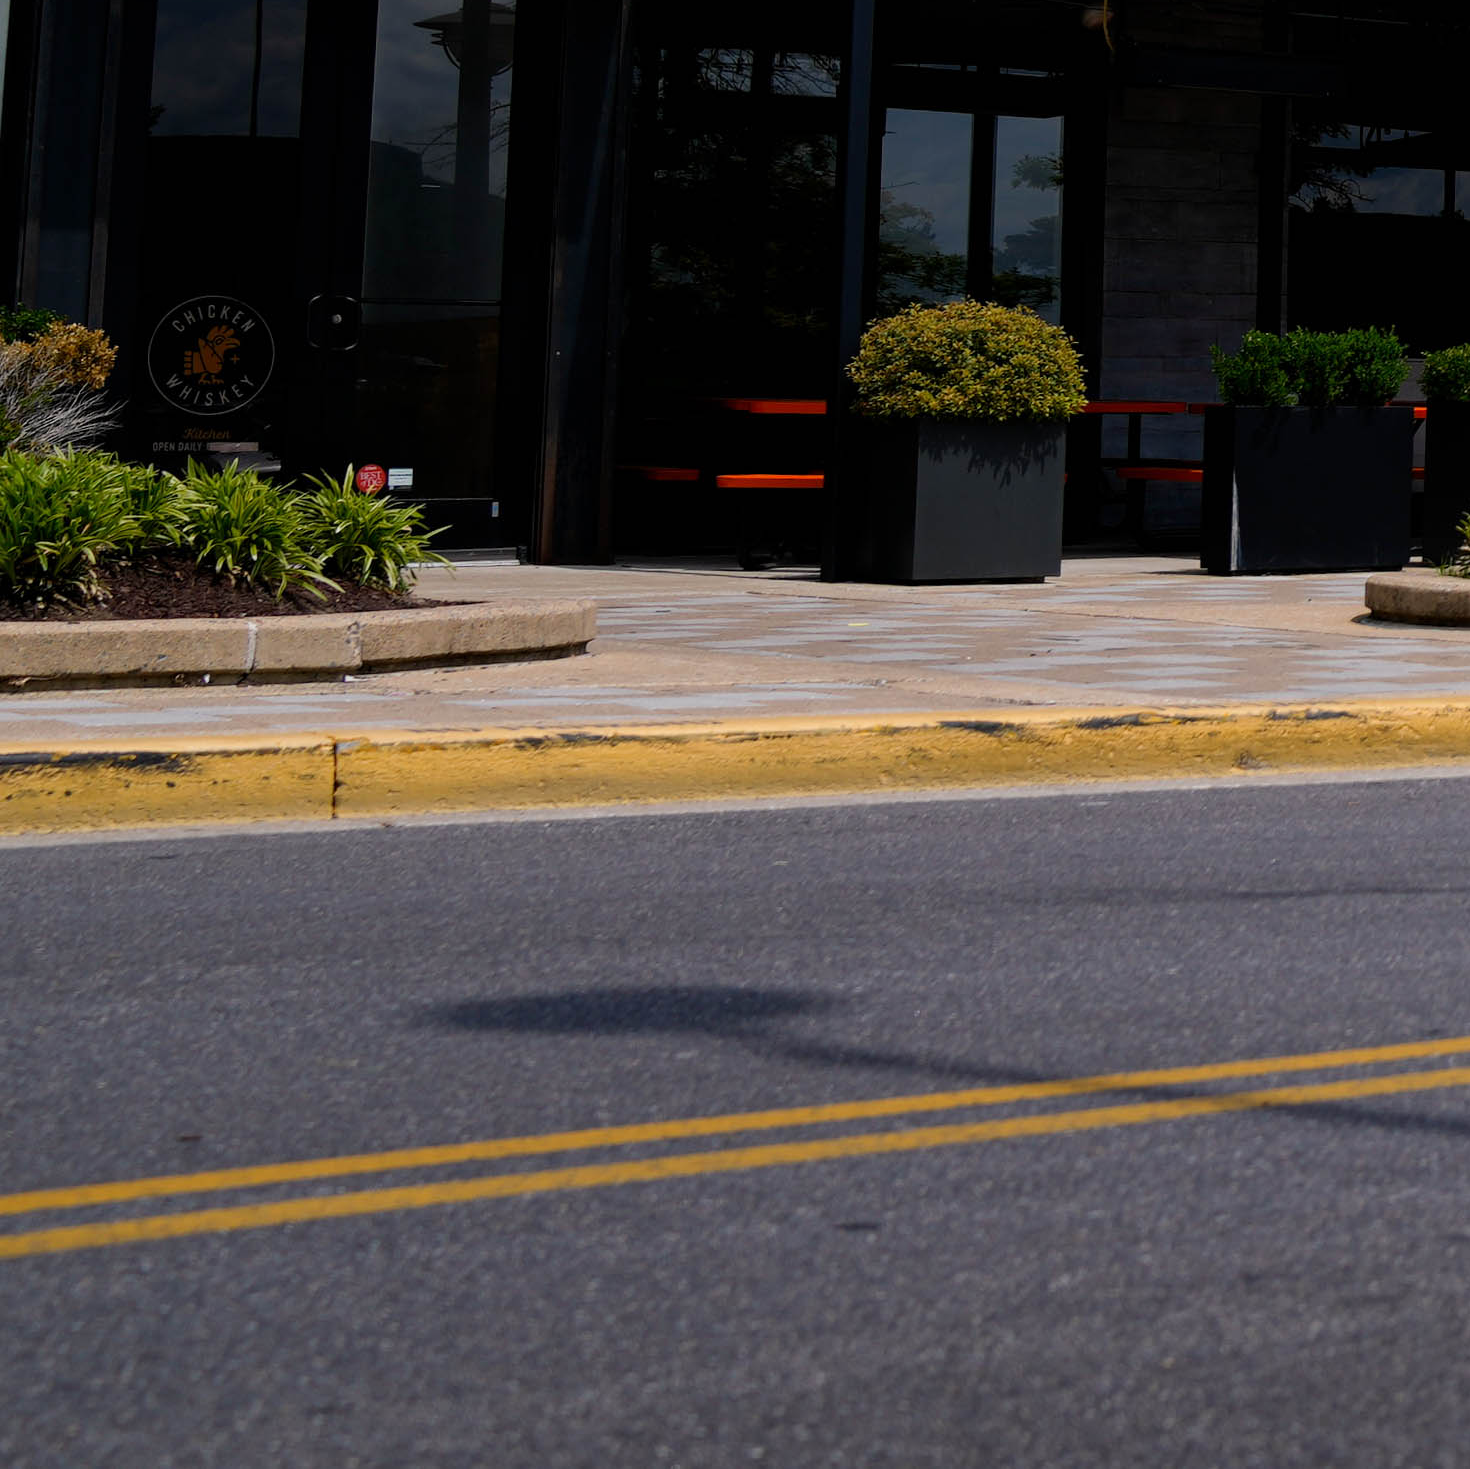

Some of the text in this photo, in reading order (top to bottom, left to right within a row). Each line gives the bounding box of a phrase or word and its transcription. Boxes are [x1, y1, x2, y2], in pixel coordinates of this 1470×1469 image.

[171, 304, 256, 333] CHICKEN
[165, 373, 256, 407] WHISKEY
[152, 441, 202, 452] OPEN DAILY
